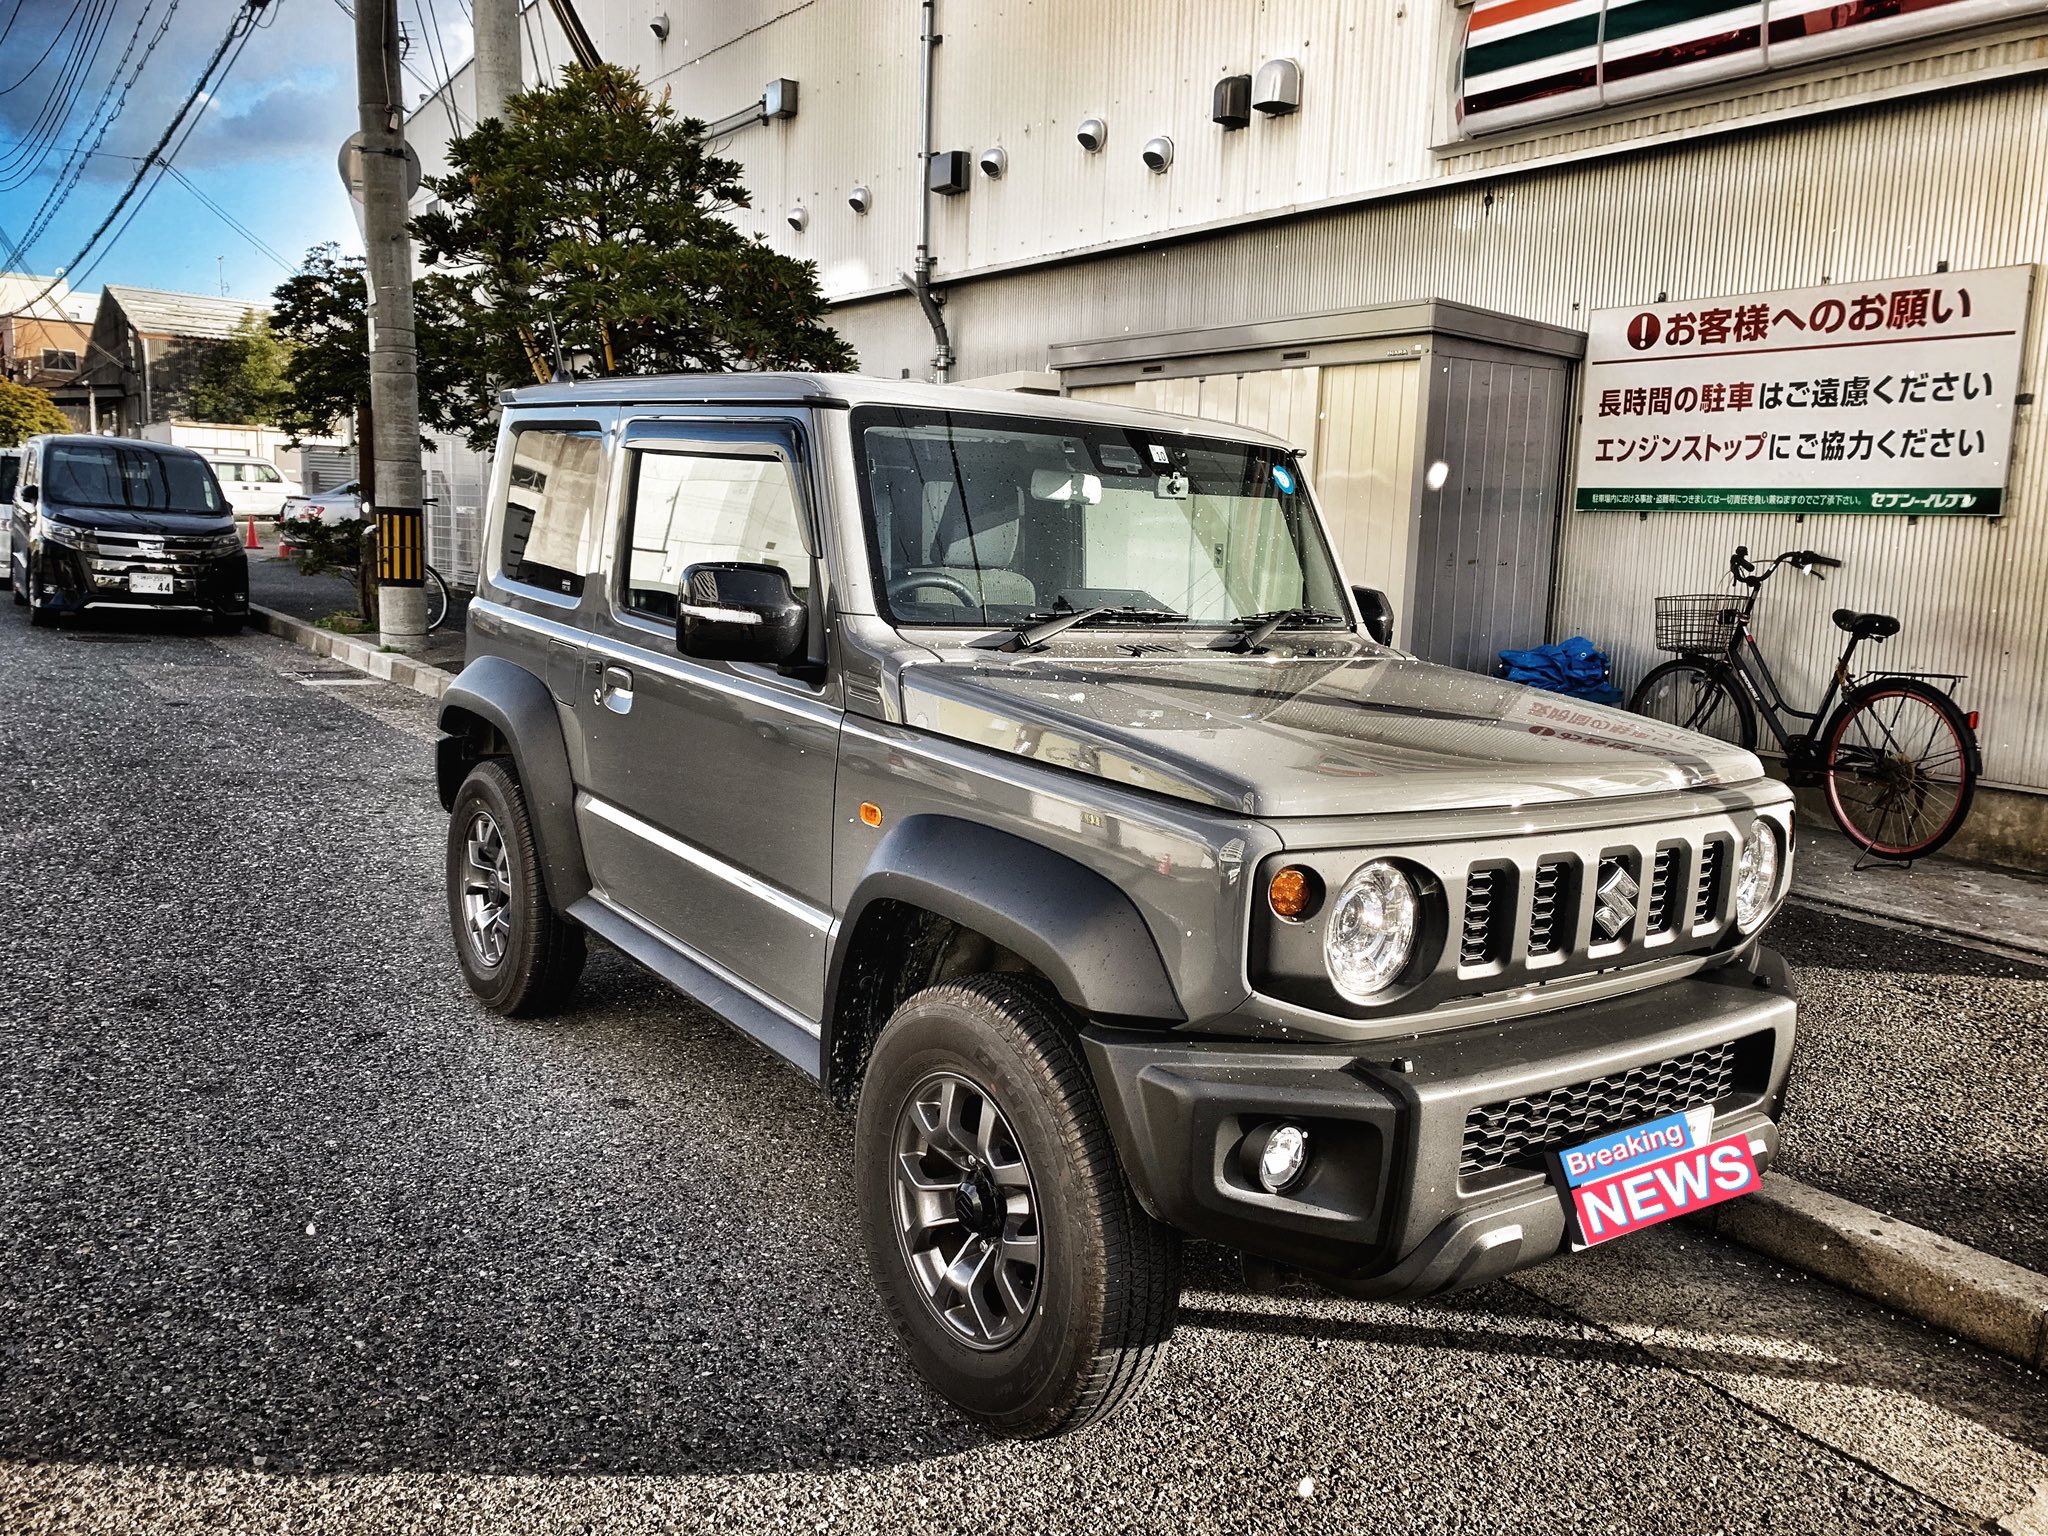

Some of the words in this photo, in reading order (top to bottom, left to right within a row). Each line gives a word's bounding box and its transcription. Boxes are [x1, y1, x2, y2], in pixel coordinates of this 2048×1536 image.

[1665, 287, 1971, 347] お客様へのお願い
[1598, 371, 1993, 417] 長時間の駐車はご遠慮ください
[1595, 428, 1985, 463] エンジンストップにご協力ください
